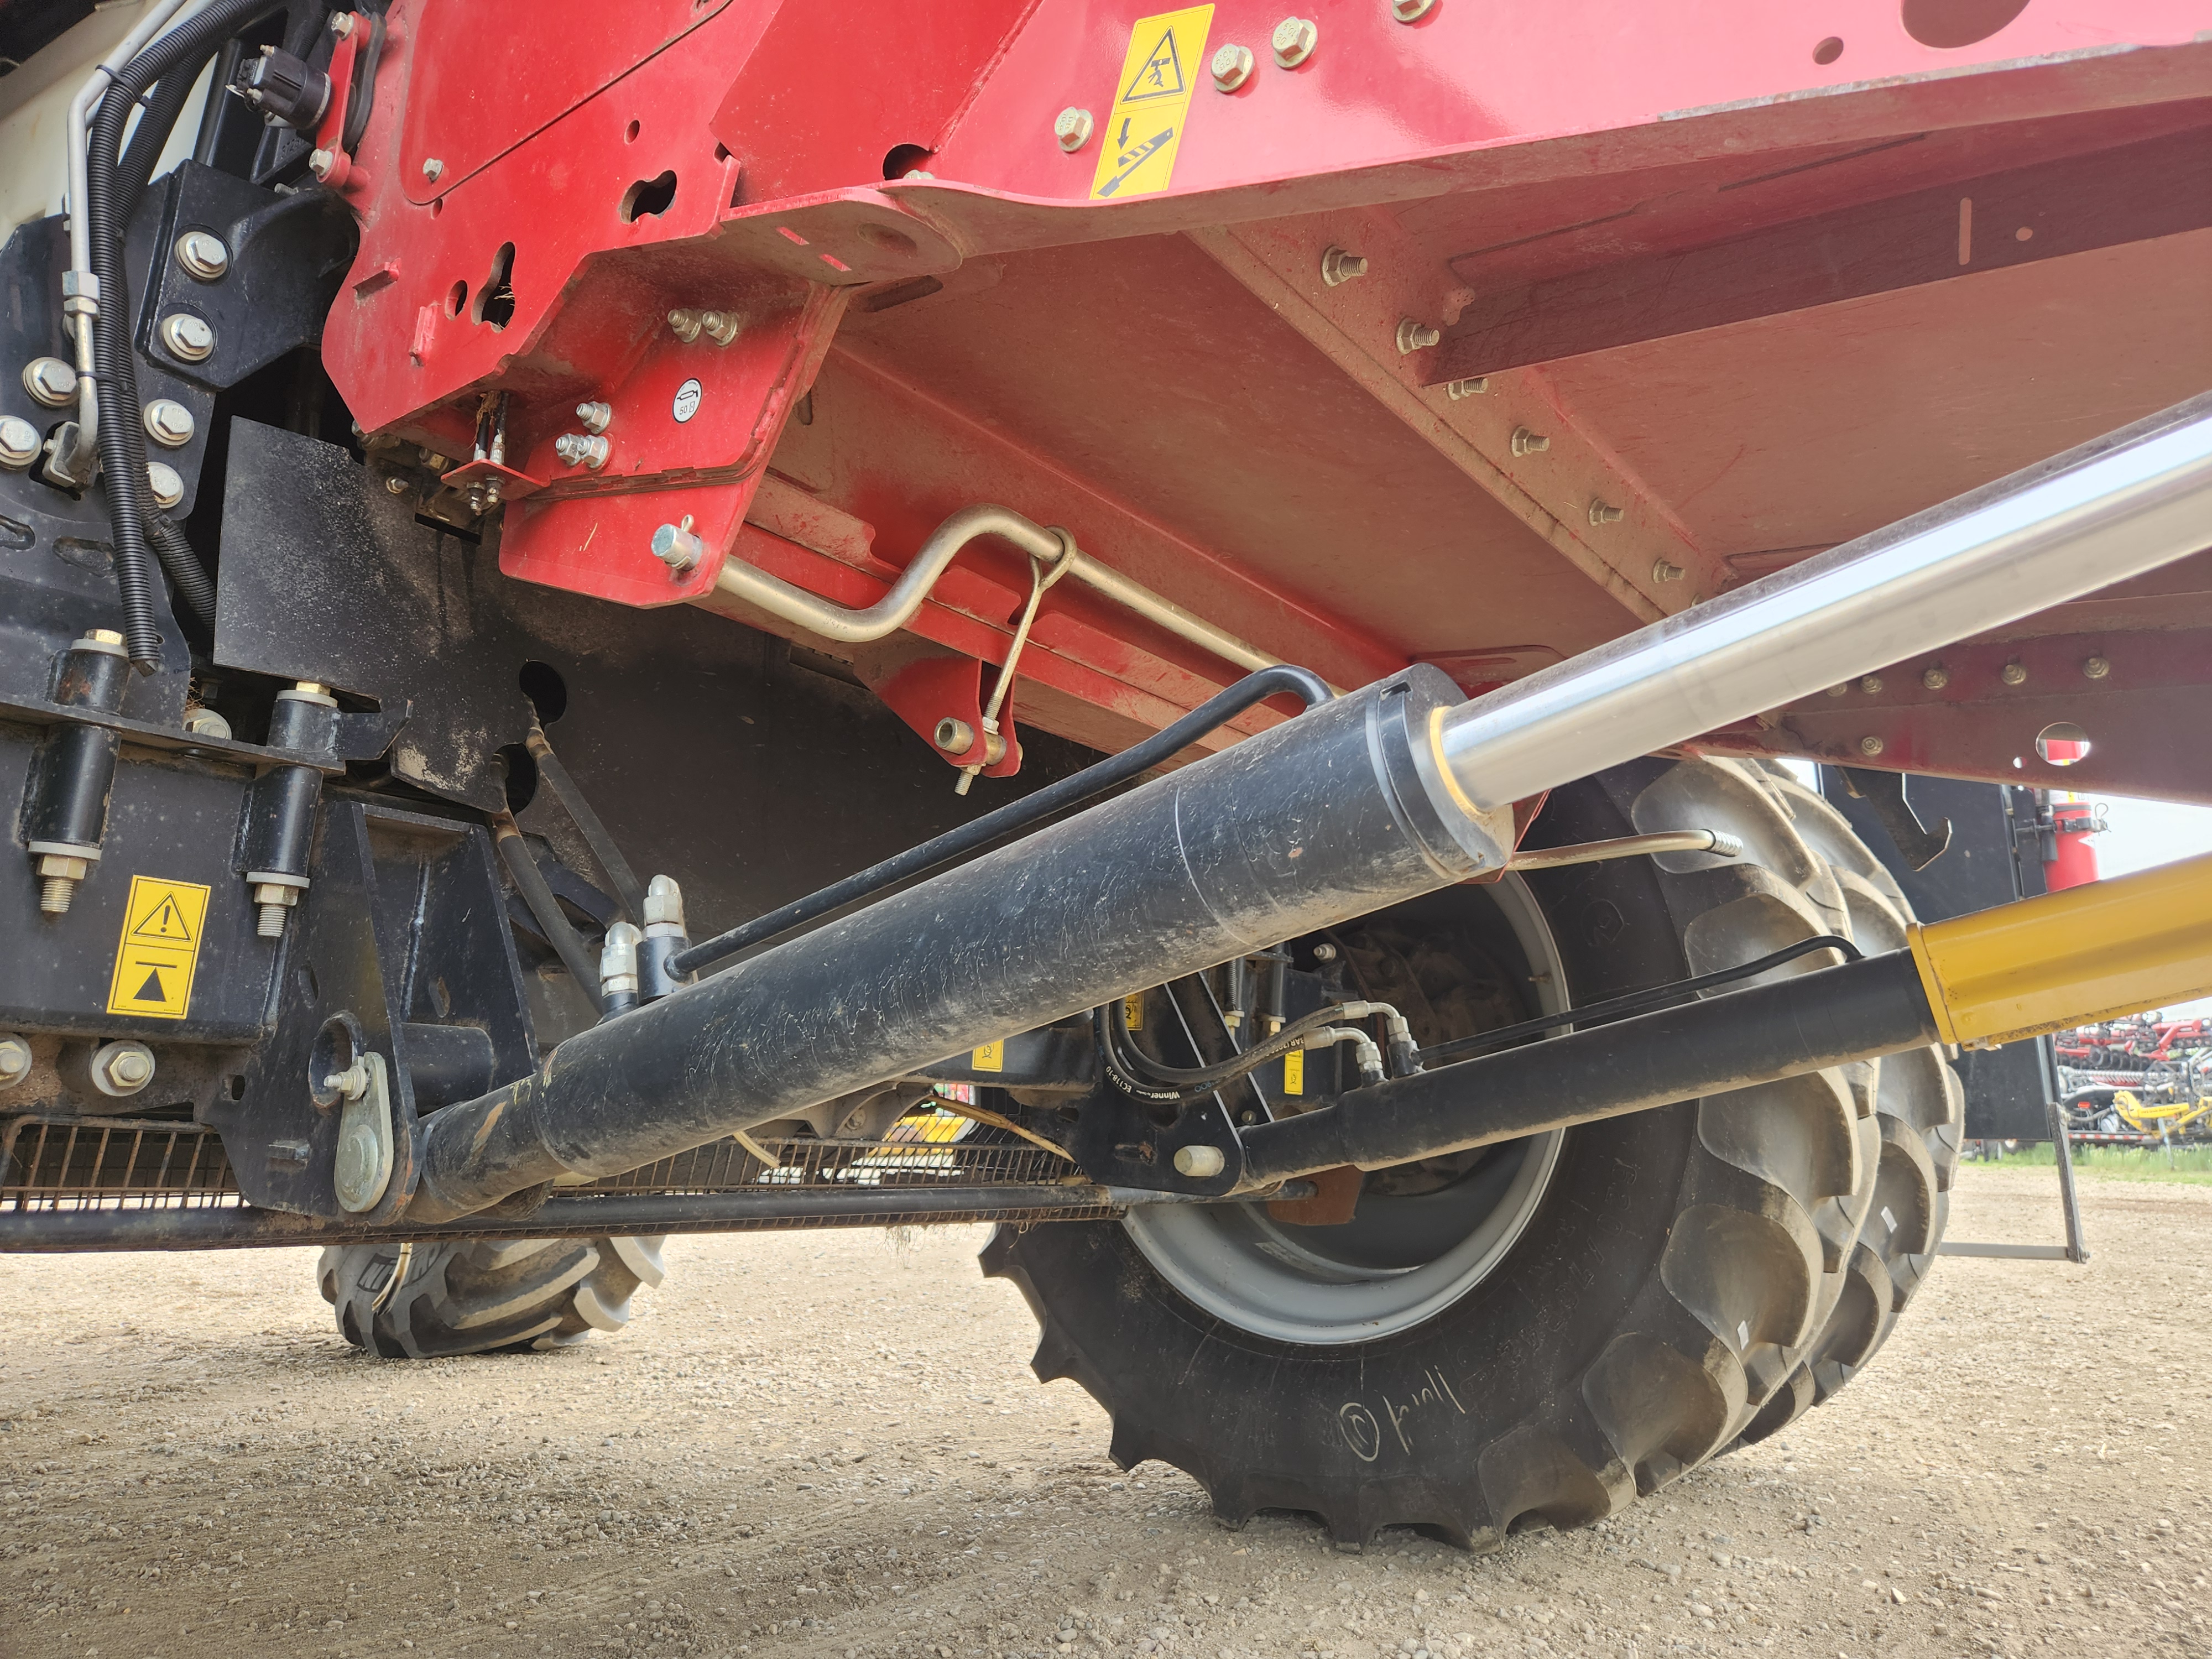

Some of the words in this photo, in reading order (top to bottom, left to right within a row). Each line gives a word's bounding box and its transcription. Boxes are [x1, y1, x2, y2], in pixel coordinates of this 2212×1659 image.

[679, 405, 687, 415] 50
[1105, 1066, 1133, 1094] EC118-10
[1150, 1091, 1181, 1100] Winner
